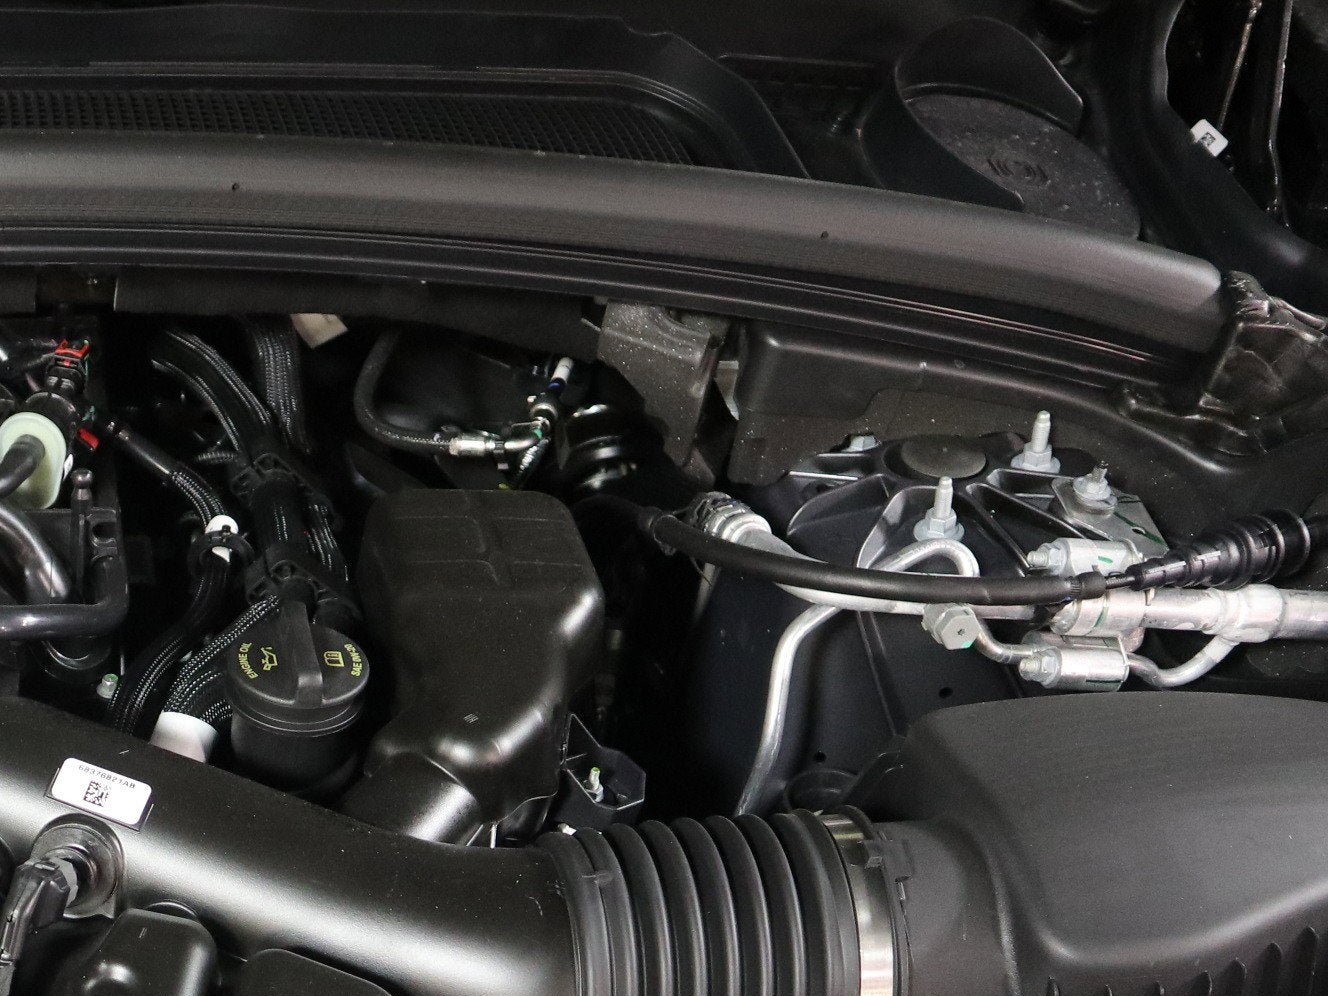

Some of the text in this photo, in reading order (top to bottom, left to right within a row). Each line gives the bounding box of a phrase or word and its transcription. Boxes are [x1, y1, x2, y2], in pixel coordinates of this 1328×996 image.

[238, 642, 259, 679] ENGINE OIL
[351, 662, 362, 677] SAE
